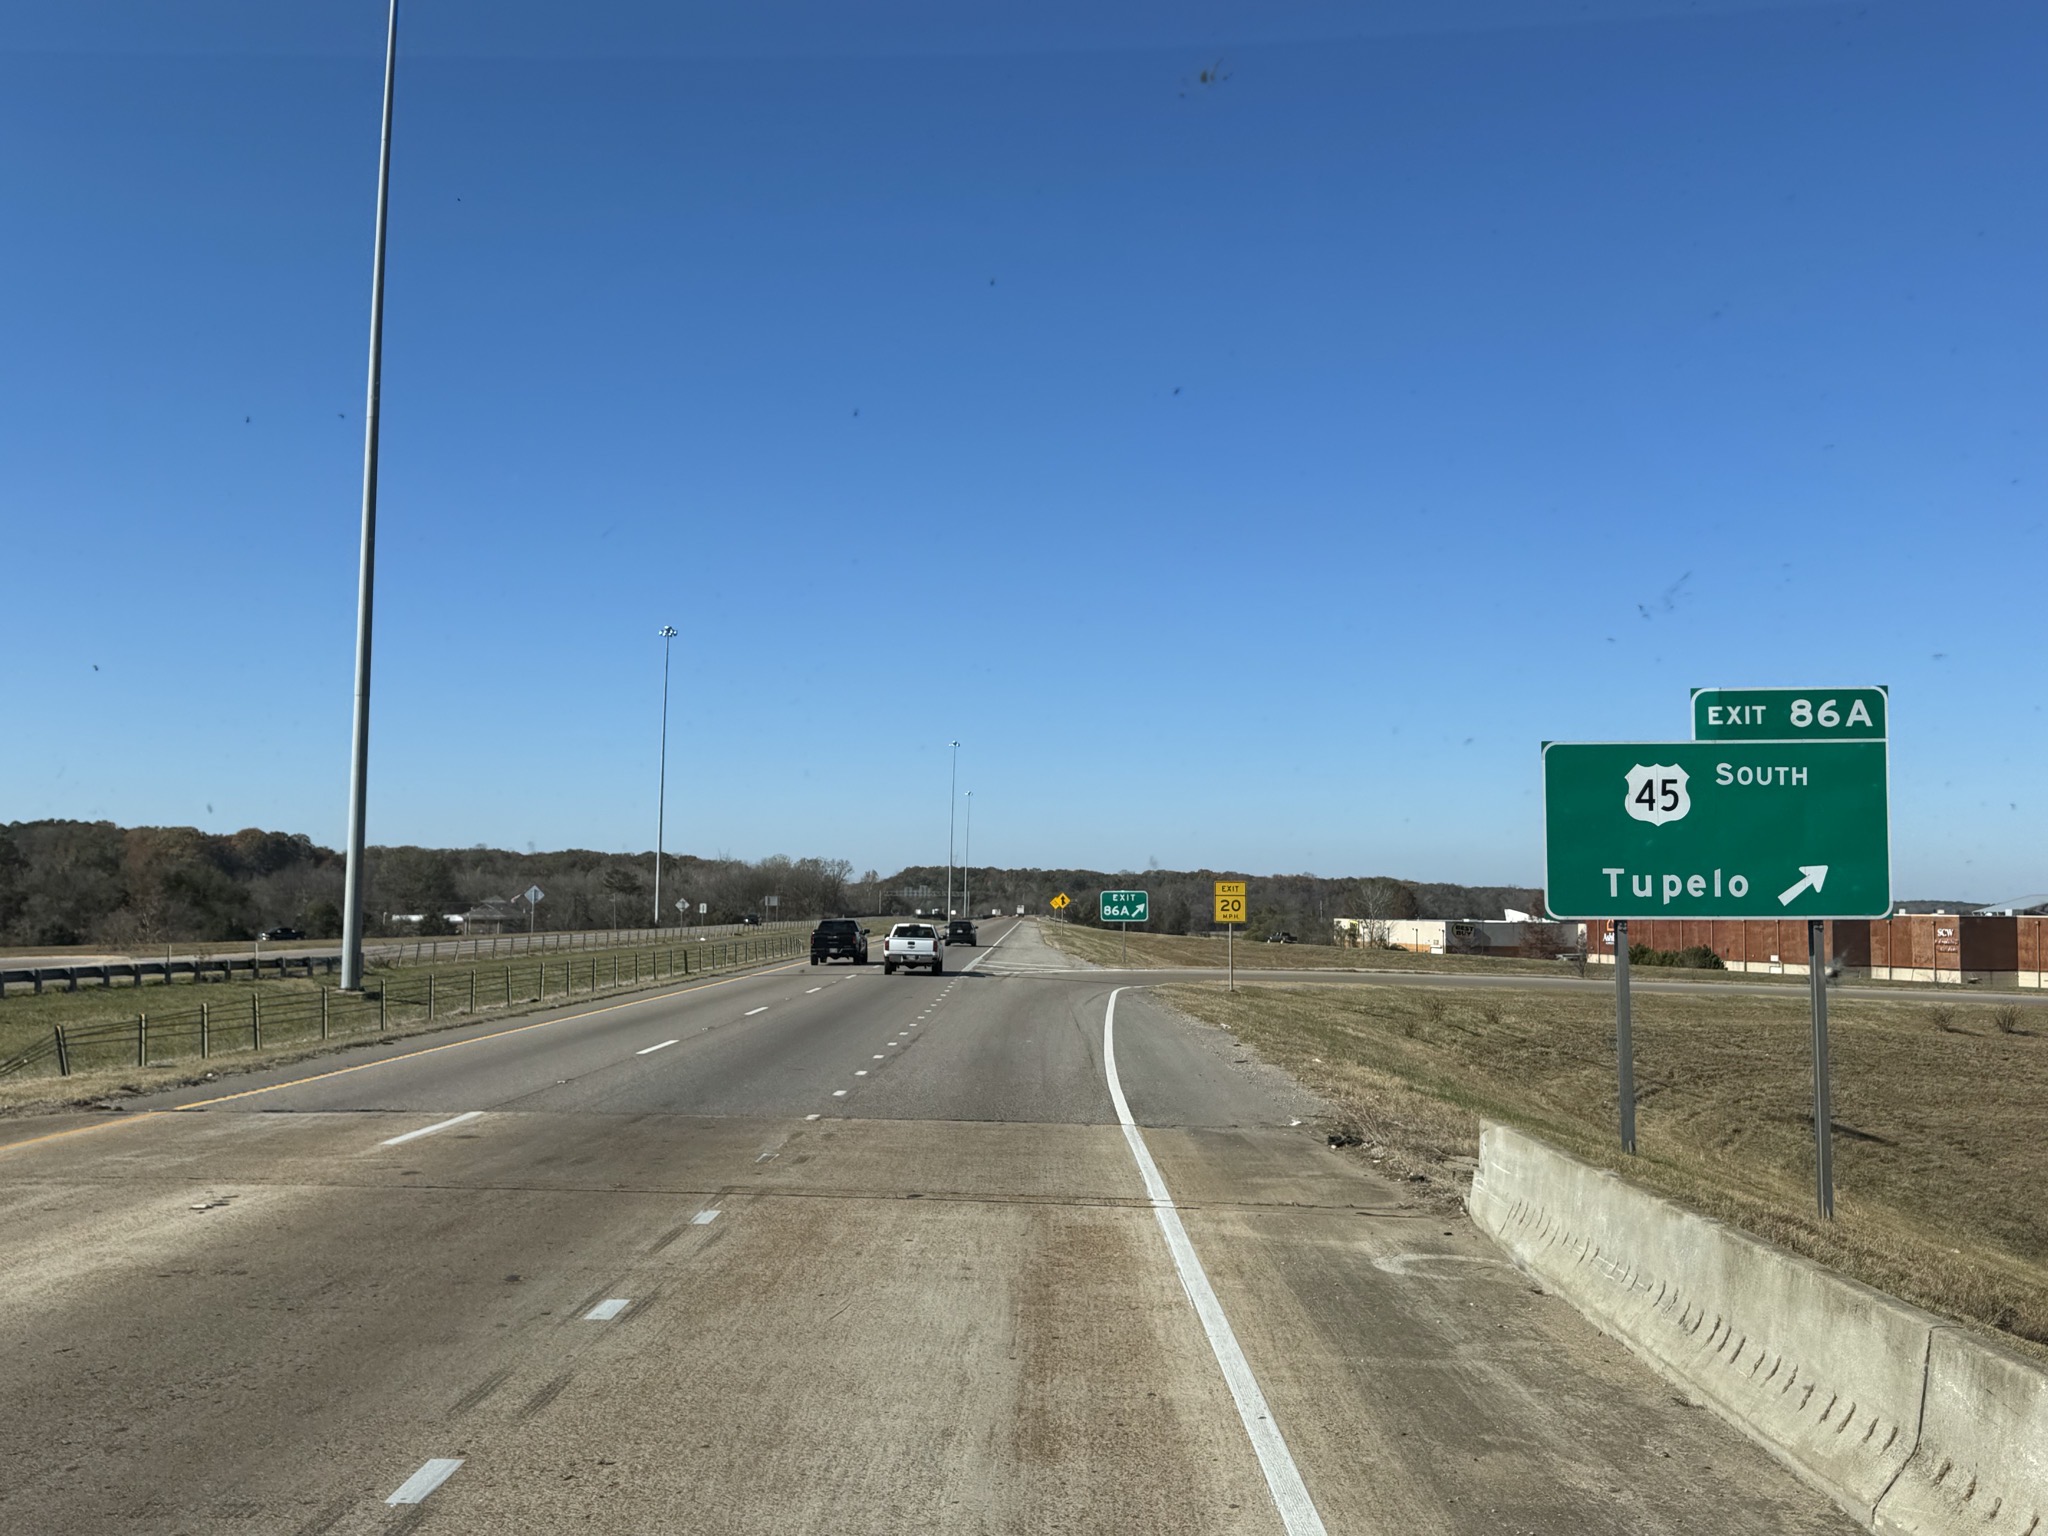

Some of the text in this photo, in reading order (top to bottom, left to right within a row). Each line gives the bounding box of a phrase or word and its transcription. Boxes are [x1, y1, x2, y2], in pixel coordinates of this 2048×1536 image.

[1708, 698, 1873, 728] EXIT 86A
[1715, 762, 1808, 786] SOUTH
[1635, 778, 1679, 812] 45
[1221, 885, 1239, 893] EXIT
[1602, 867, 1749, 905] Tupelo
[1112, 893, 1136, 902] EXIT
[1103, 905, 1130, 916] 86A
[1220, 899, 1241, 912] 20
[1455, 924, 1474, 932] BEST
